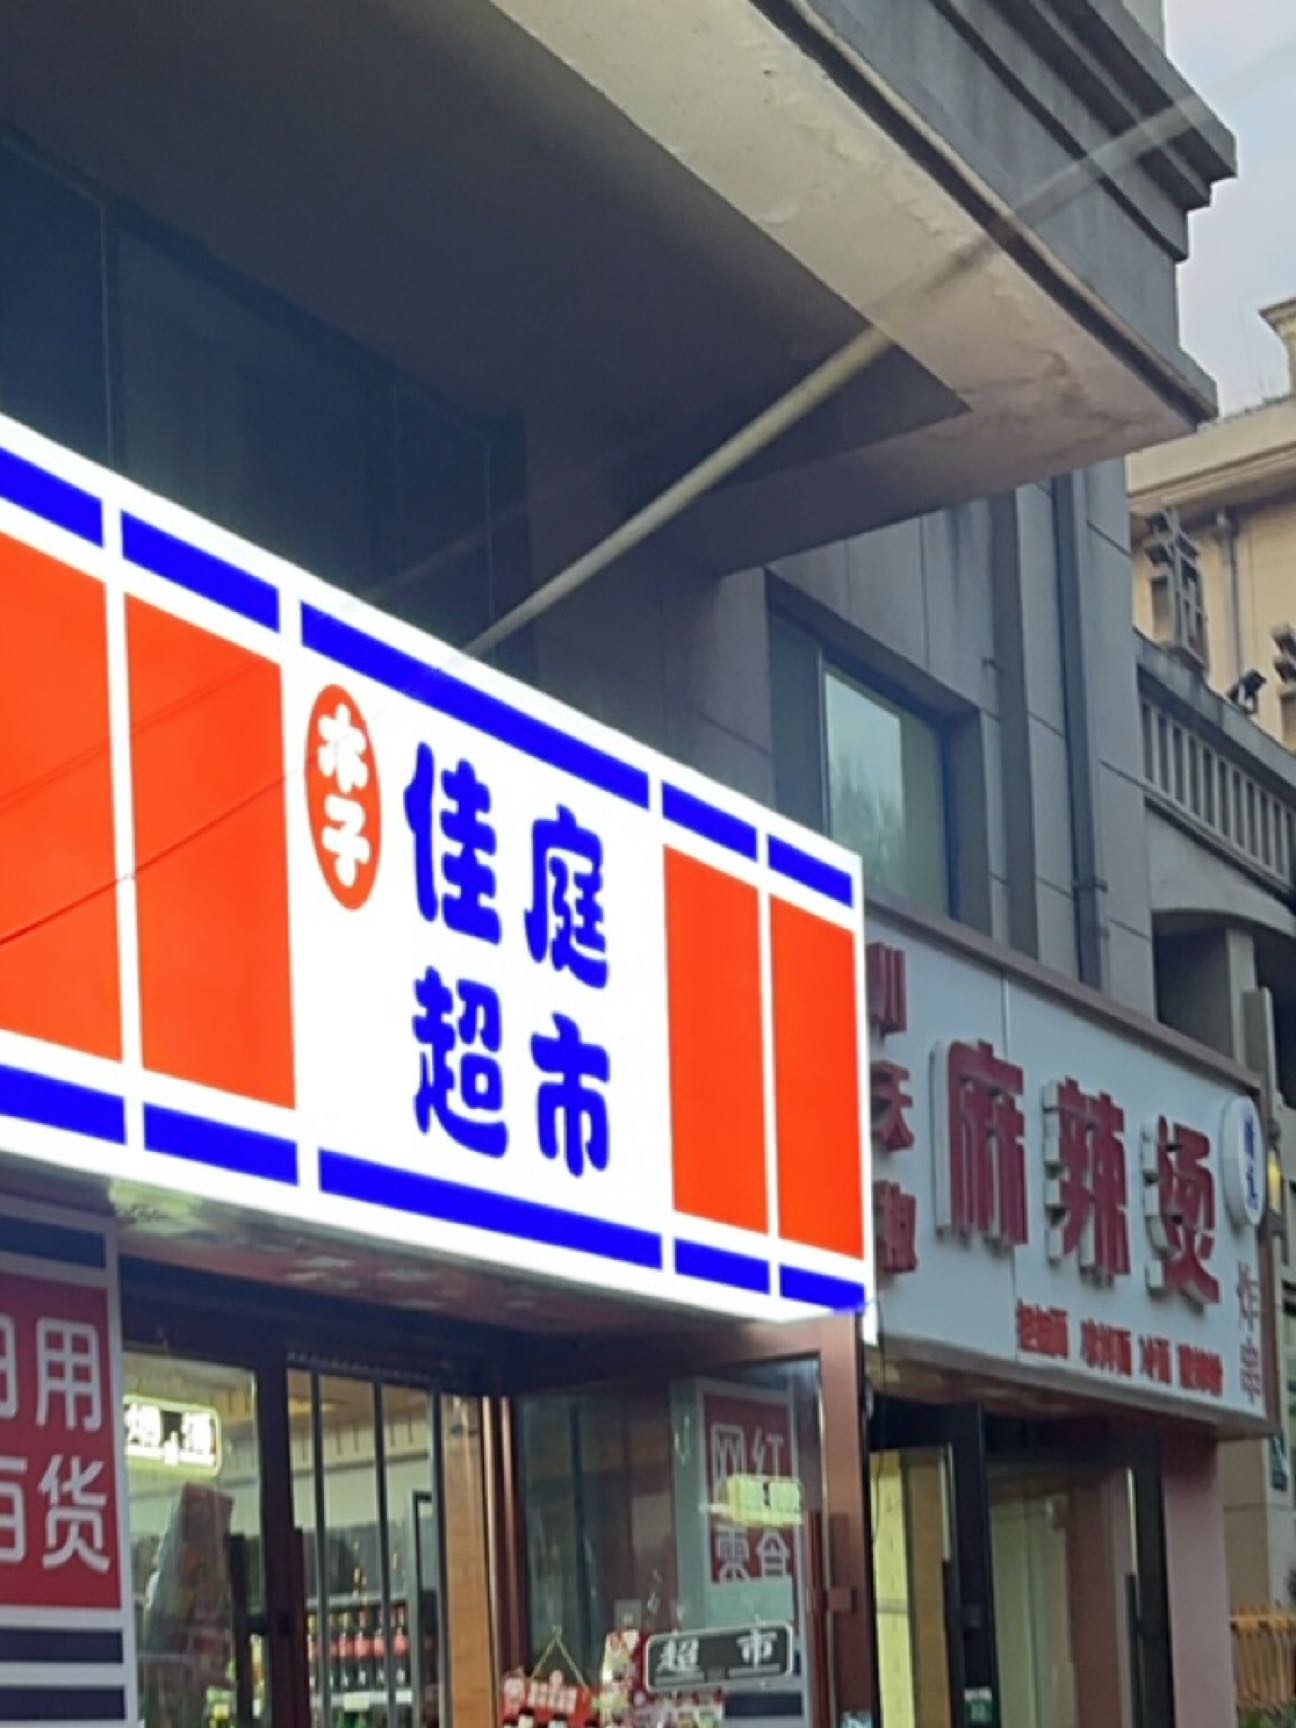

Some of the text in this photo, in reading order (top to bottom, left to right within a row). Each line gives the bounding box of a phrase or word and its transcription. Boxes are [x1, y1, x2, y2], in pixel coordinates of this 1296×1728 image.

[317, 703, 370, 888] 木子
[404, 742, 609, 989] 佳庭
[412, 966, 610, 1178] 超市
[932, 1038, 1221, 1305] 麻辣烫
